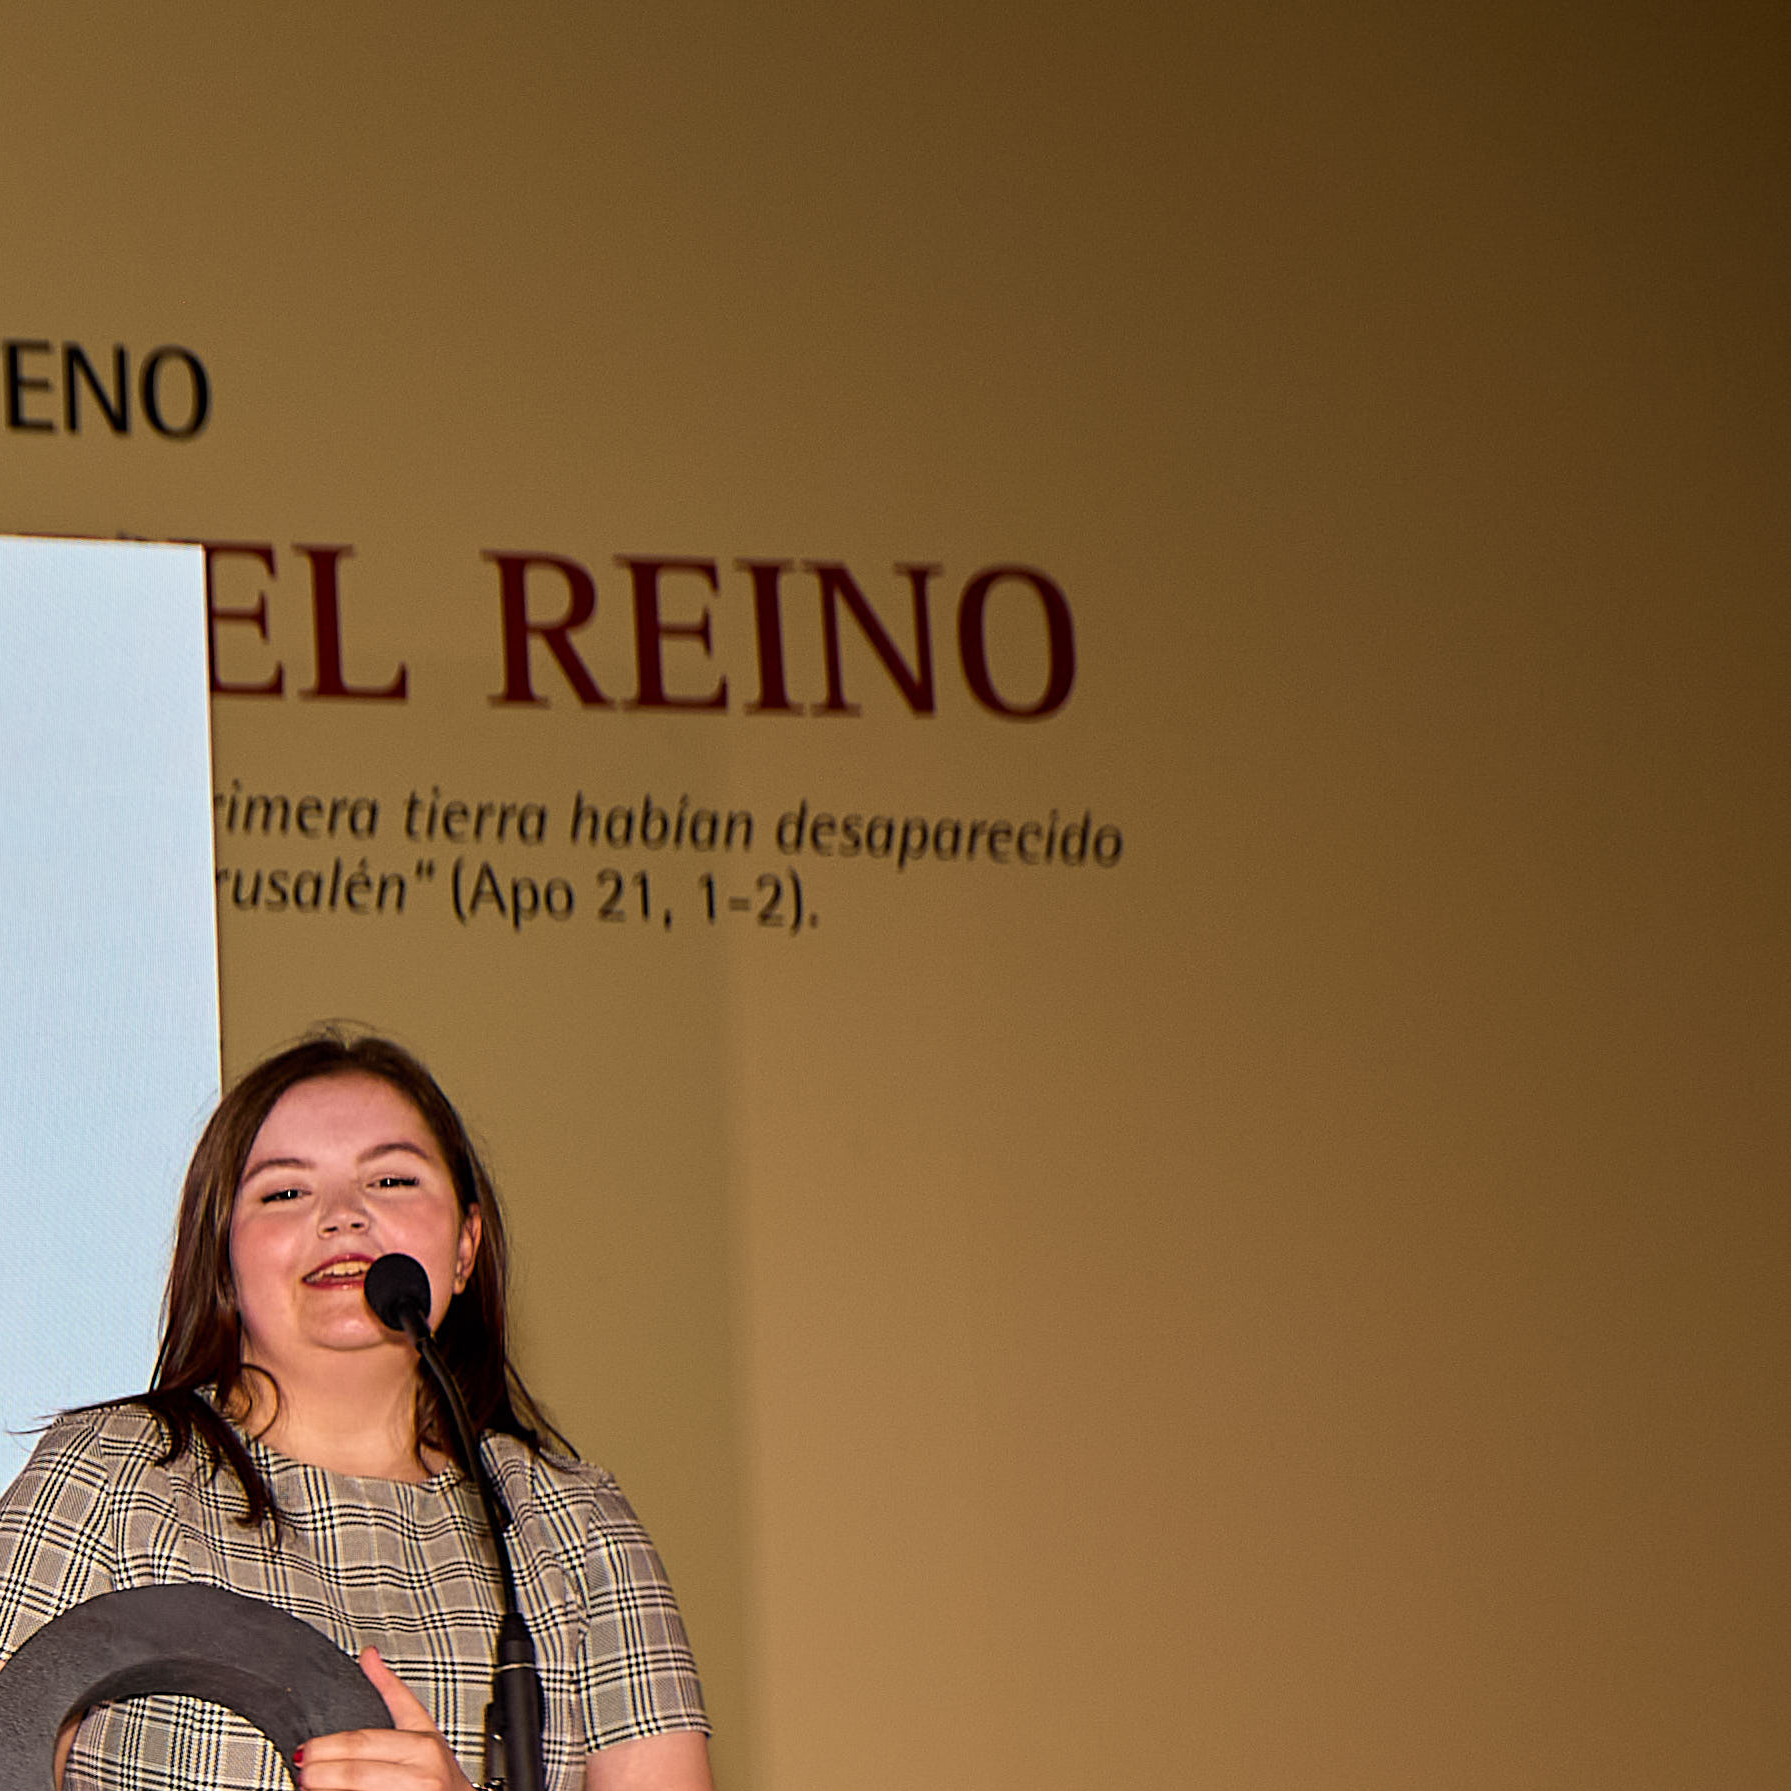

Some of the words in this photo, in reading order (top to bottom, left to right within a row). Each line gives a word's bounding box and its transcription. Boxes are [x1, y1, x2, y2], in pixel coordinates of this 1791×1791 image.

[203, 541, 410, 703] EL
[481, 548, 1079, 724] REINO
[213, 778, 380, 840] rimera
[402, 784, 549, 846] tierra
[568, 790, 755, 854] habían
[773, 797, 1126, 872] desaparecido
[449, 855, 577, 932] (Apo
[595, 866, 674, 933] 21,
